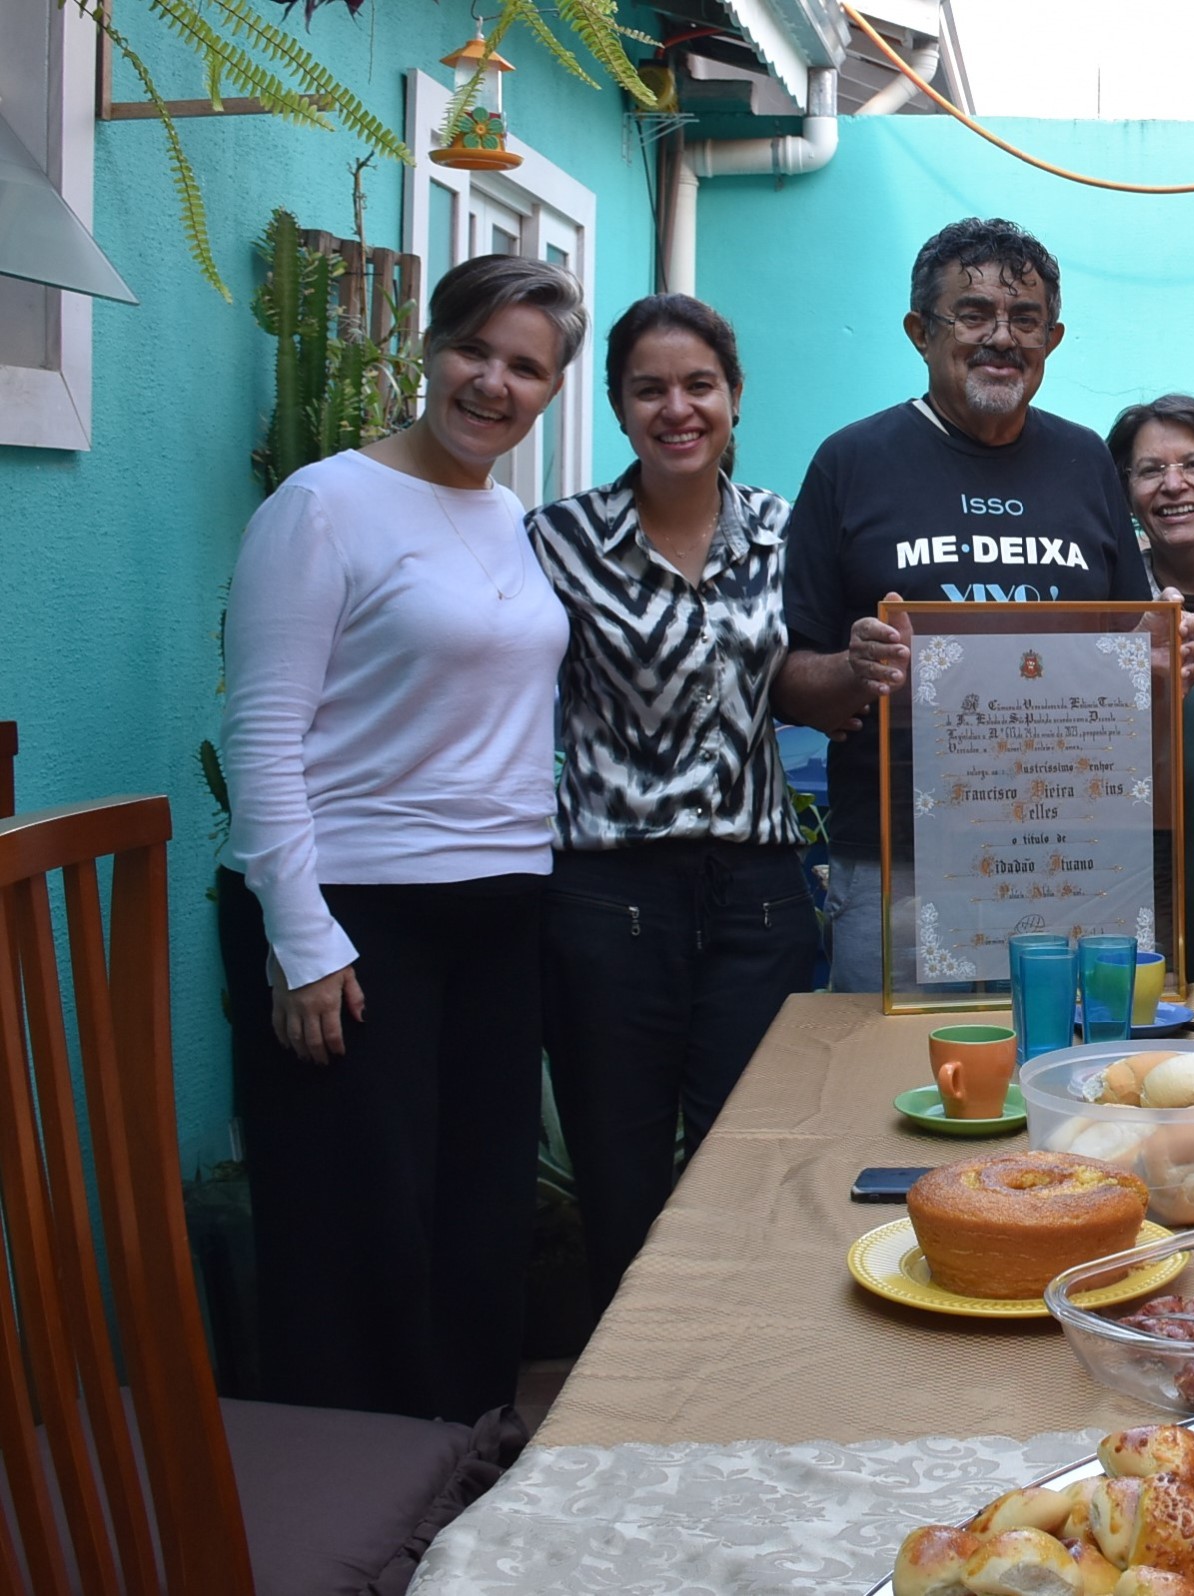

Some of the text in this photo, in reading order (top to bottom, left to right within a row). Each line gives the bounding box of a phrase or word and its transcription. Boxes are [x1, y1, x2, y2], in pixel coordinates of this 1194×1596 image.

[896, 535, 1089, 571] ME DEIXA
[979, 855, 1035, 876] Cidadão
